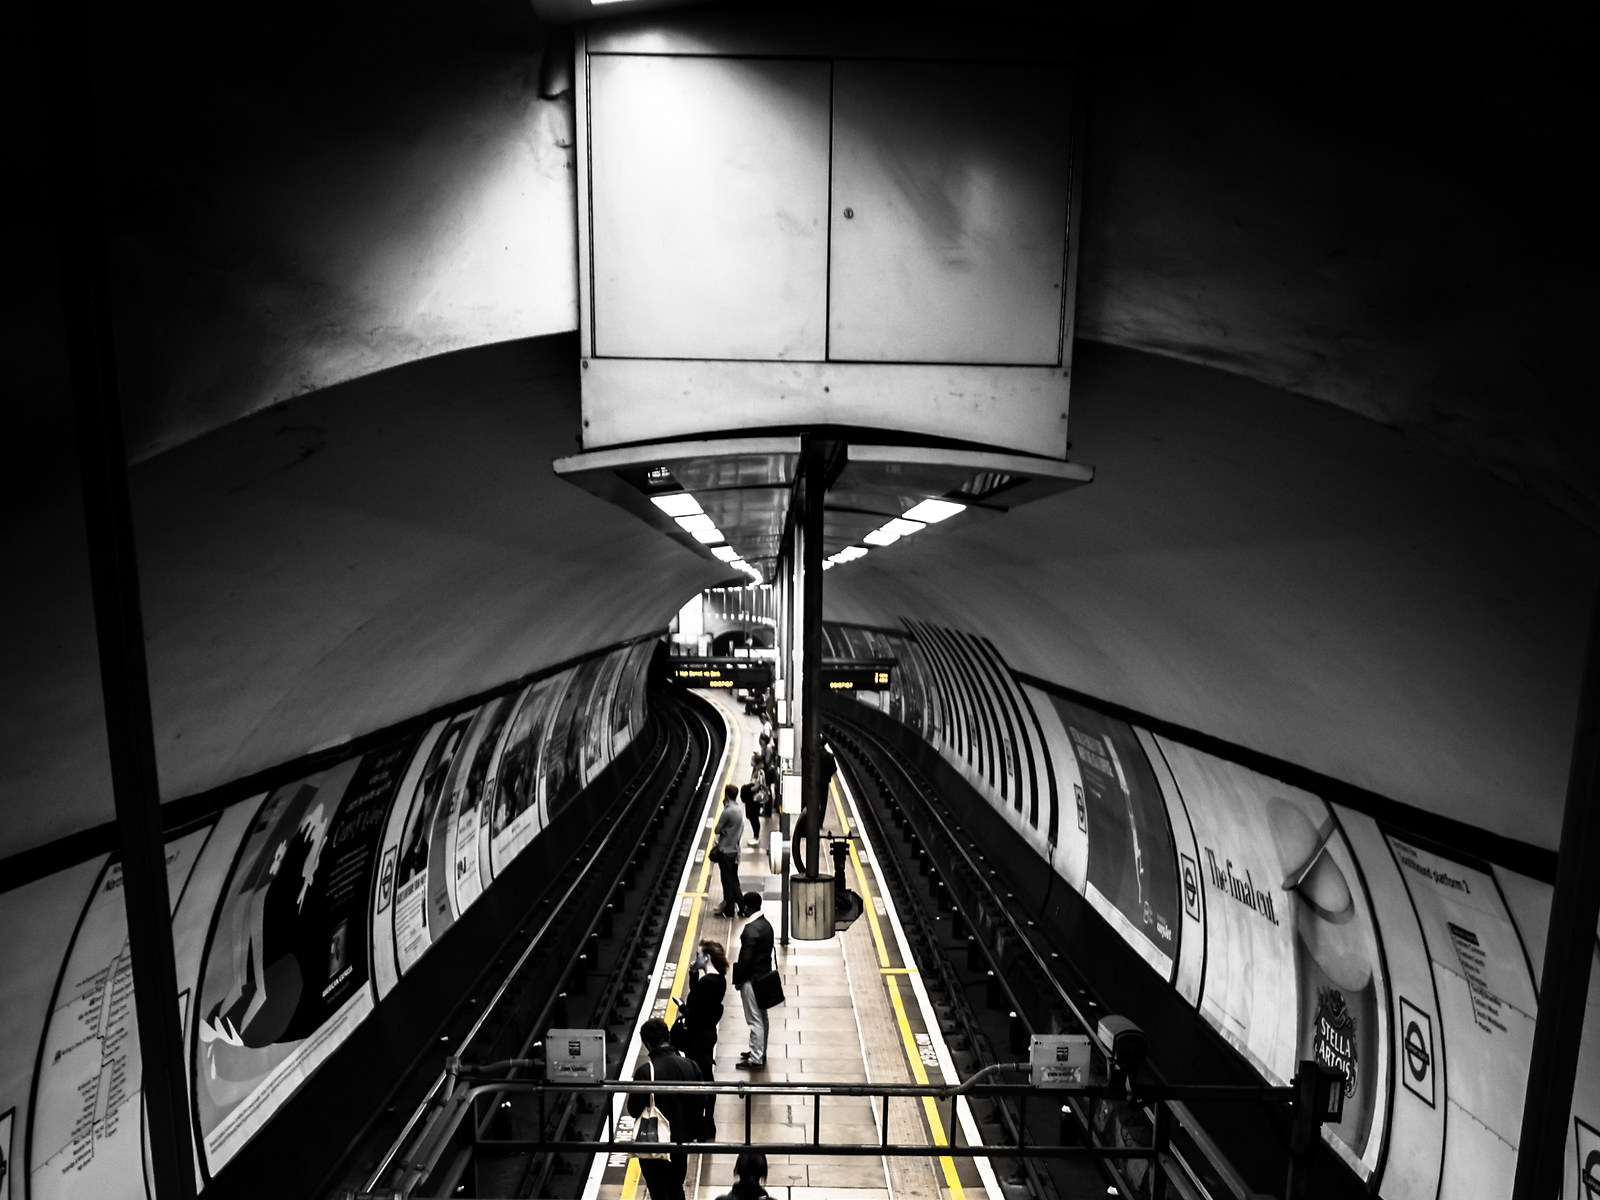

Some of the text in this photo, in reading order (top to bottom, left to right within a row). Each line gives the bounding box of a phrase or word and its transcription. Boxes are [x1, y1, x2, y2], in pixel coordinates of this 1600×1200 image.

[1205, 846, 1279, 926] The final cut.
[1321, 1017, 1351, 1058] STELLA
